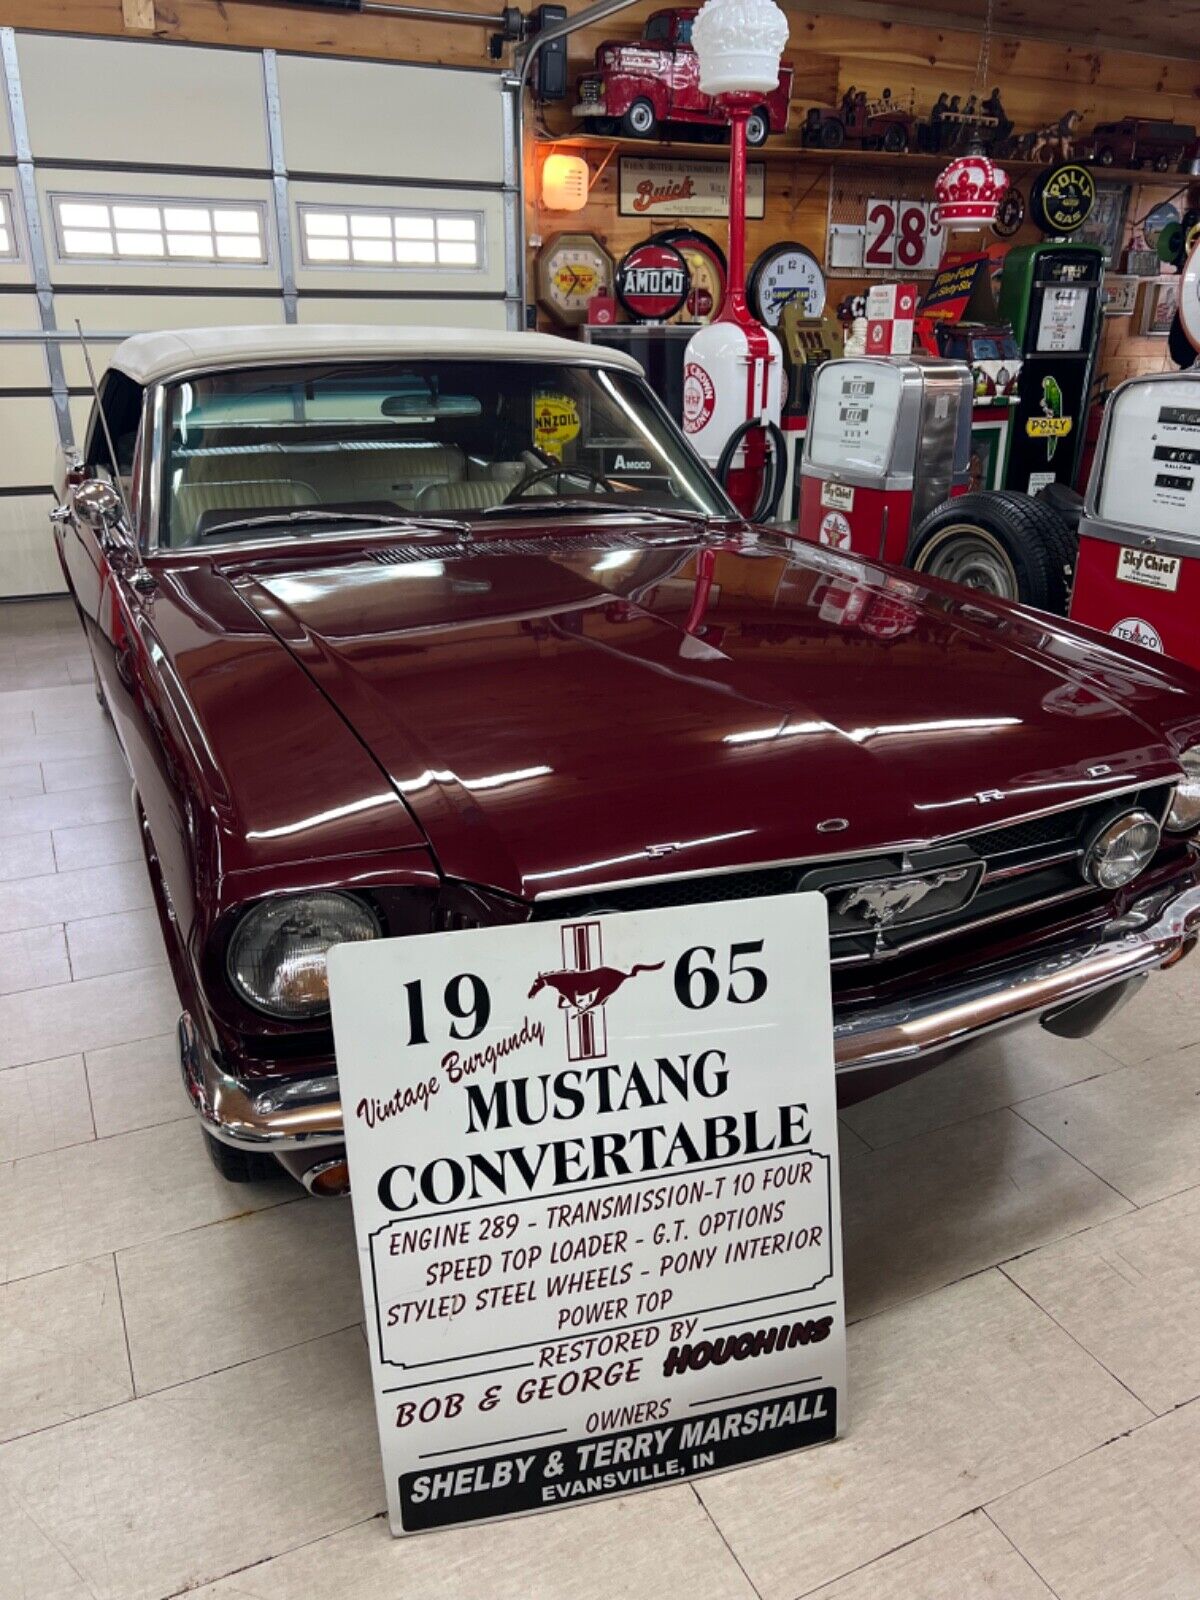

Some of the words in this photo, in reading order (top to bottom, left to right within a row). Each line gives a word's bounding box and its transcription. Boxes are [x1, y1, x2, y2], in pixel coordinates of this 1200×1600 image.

[633, 175, 697, 211] Buick
[1049, 171, 1091, 198] POLLY
[1054, 210, 1081, 223] GAS
[623, 271, 685, 293] AMOCO
[536, 414, 578, 428] NNZOIL
[1032, 420, 1067, 431] POLLY
[1123, 550, 1143, 570] Sky
[1144, 555, 1176, 574] Chief
[403, 973, 491, 1046] 19
[674, 938, 768, 1010] 65
[356, 1076, 441, 1129] Vintage
[441, 1016, 545, 1084] Burgundy
[464, 1049, 729, 1134] MUSTANG
[377, 1103, 812, 1212] CONVERTABLE
[389, 1221, 471, 1256] ENGINE
[478, 1213, 519, 1241] 289
[733, 1172, 755, 1197] 10
[762, 1161, 813, 1191] FOUR
[426, 1254, 492, 1287] SPEED
[501, 1245, 542, 1273] TOP
[550, 1230, 628, 1265] LOADER
[653, 1219, 689, 1246] G.T.
[699, 1200, 786, 1237] OPTIONS
[387, 1293, 467, 1327] STYLED
[475, 1280, 537, 1312] STEEL
[546, 1261, 633, 1299] WHEELS
[660, 1246, 717, 1277] PONY
[725, 1226, 823, 1264] INTERIOR
[558, 1298, 628, 1330] POWER
[635, 1289, 674, 1315] TOP
[539, 1326, 660, 1369] RESTORED
[670, 1317, 699, 1343] BY
[396, 1393, 465, 1428] BOB
[478, 1385, 502, 1412] &
[516, 1358, 643, 1404] GEORGE
[663, 1315, 833, 1377] HOUCHINS
[586, 1398, 672, 1434] OWNERS
[410, 1455, 536, 1504] SHELBY
[543, 1450, 565, 1479] &
[576, 1427, 674, 1471] TERRY
[679, 1394, 828, 1450] MARSHALL
[542, 1459, 686, 1502] EVANSVILLE,
[693, 1451, 715, 1470] IN
